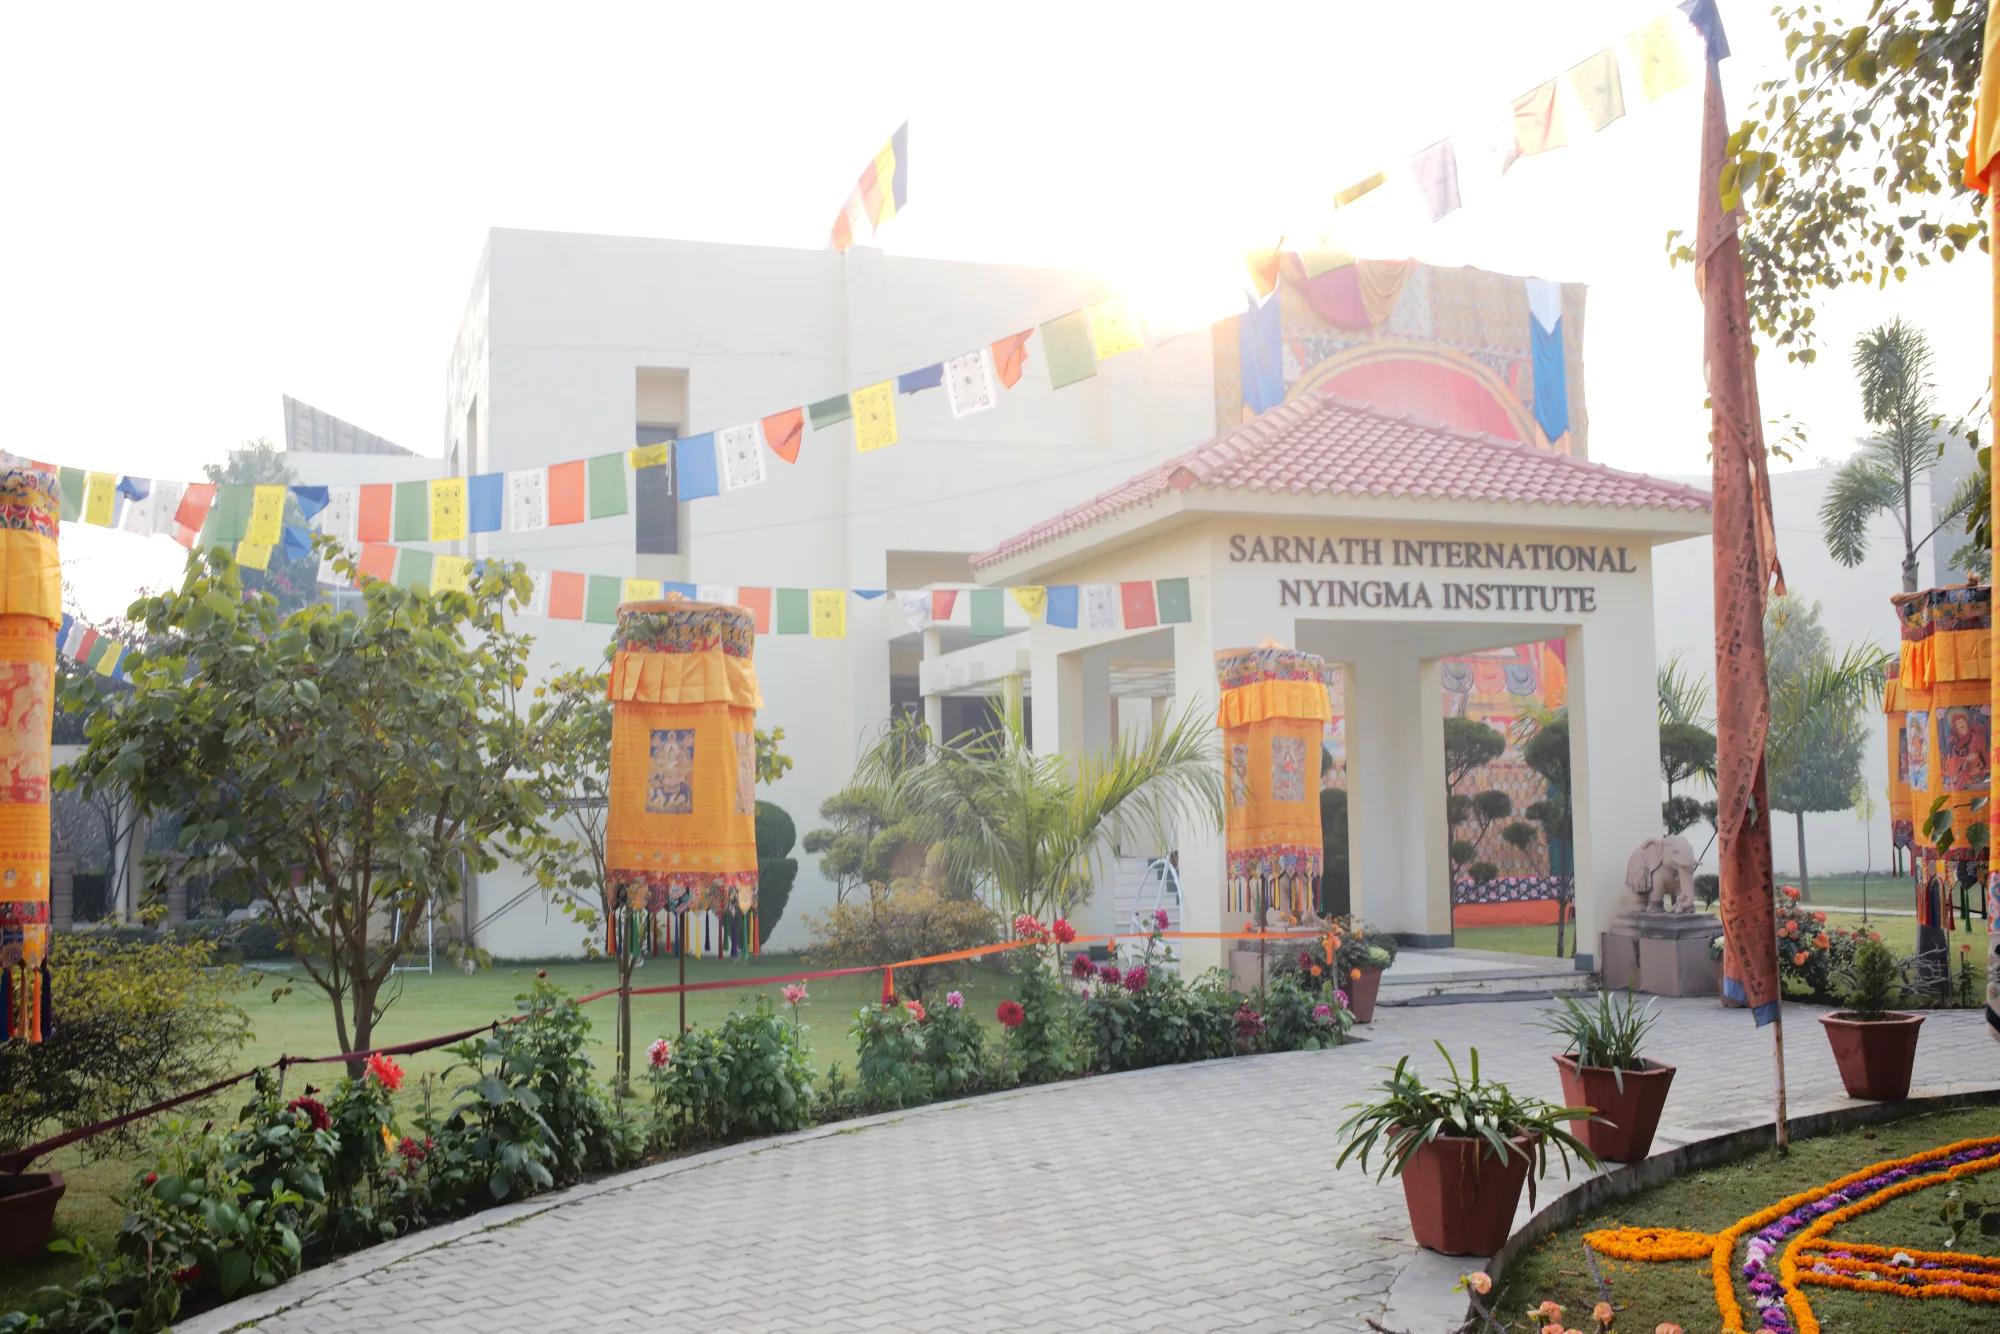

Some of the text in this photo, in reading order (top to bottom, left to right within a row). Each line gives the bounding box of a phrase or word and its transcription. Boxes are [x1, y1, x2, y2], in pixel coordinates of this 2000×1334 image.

[1229, 534, 1637, 573] SARNATH INTERNATIONAL
[1278, 579, 1597, 613] NYINGMA INSTITUTE
